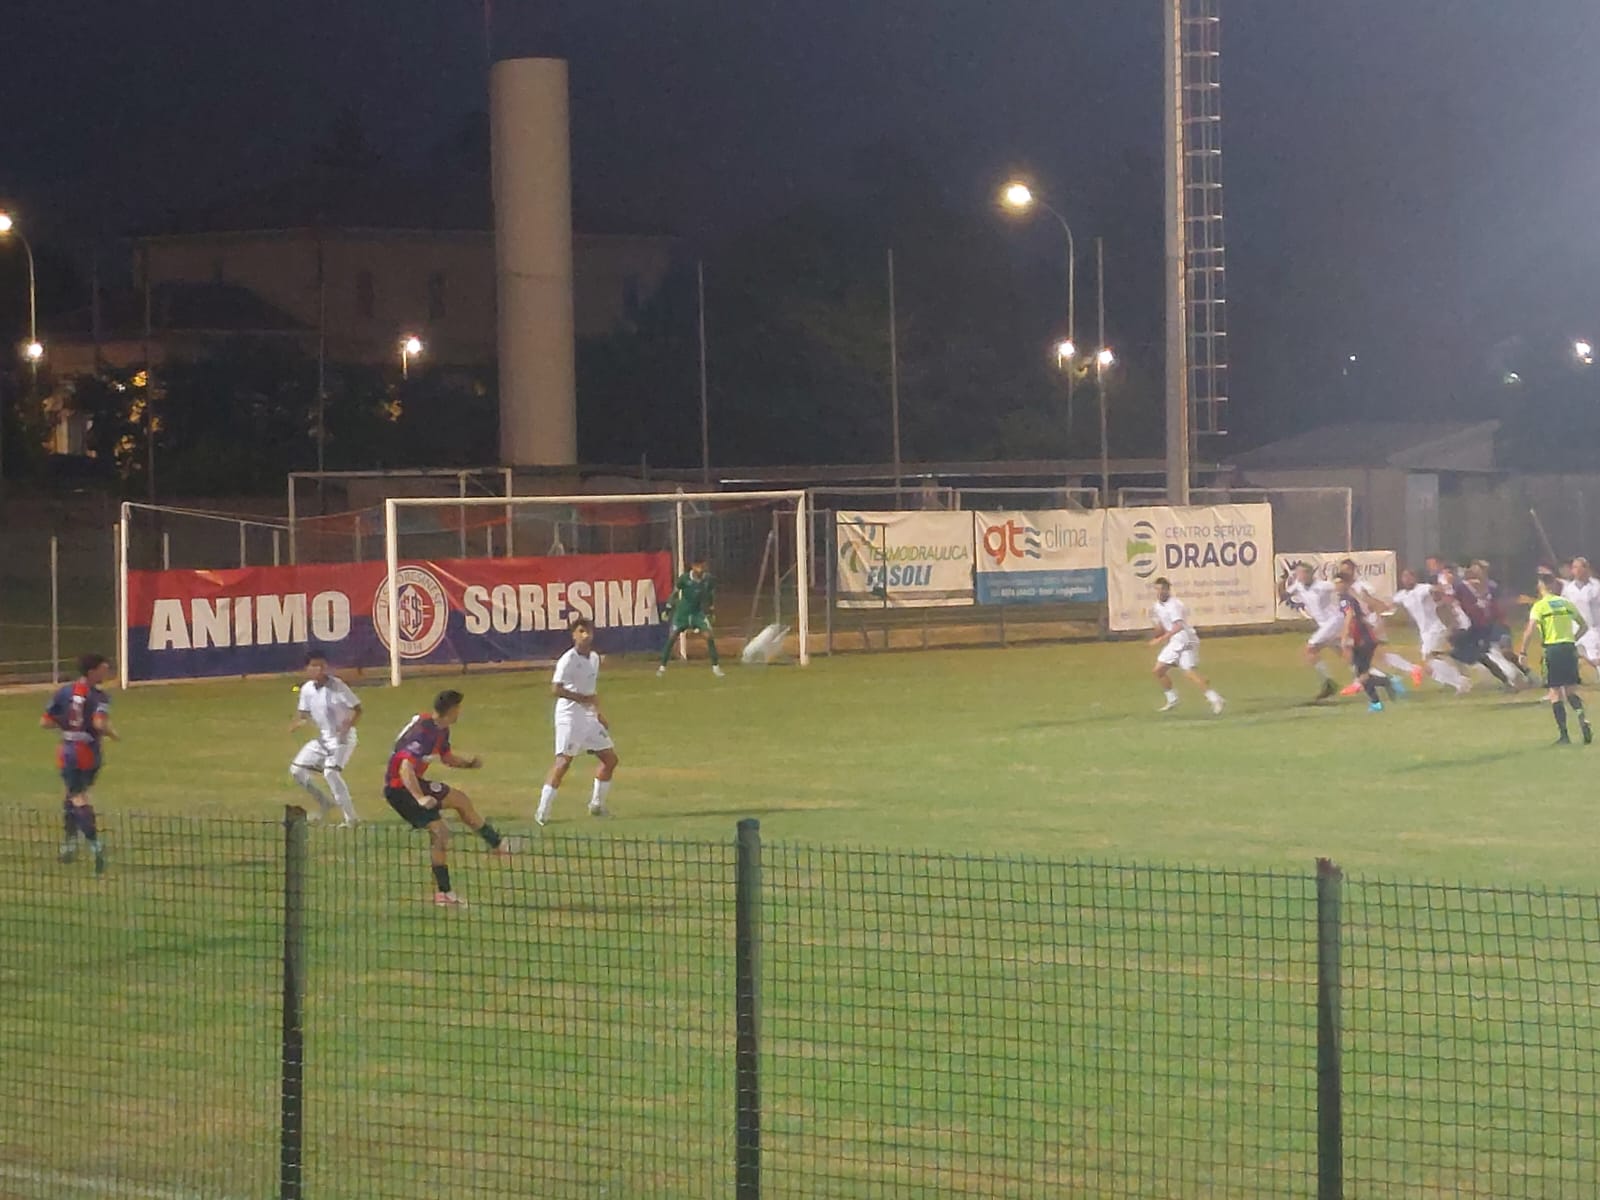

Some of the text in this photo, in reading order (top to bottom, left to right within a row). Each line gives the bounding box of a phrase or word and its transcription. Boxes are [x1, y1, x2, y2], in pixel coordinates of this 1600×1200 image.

[1044, 523, 1088, 548] clima
[1164, 524, 1256, 538] CENTRO SERVIZI
[1165, 541, 1258, 569] DRAGO
[148, 590, 351, 650] ANIMO
[463, 578, 660, 634] SORESINA
